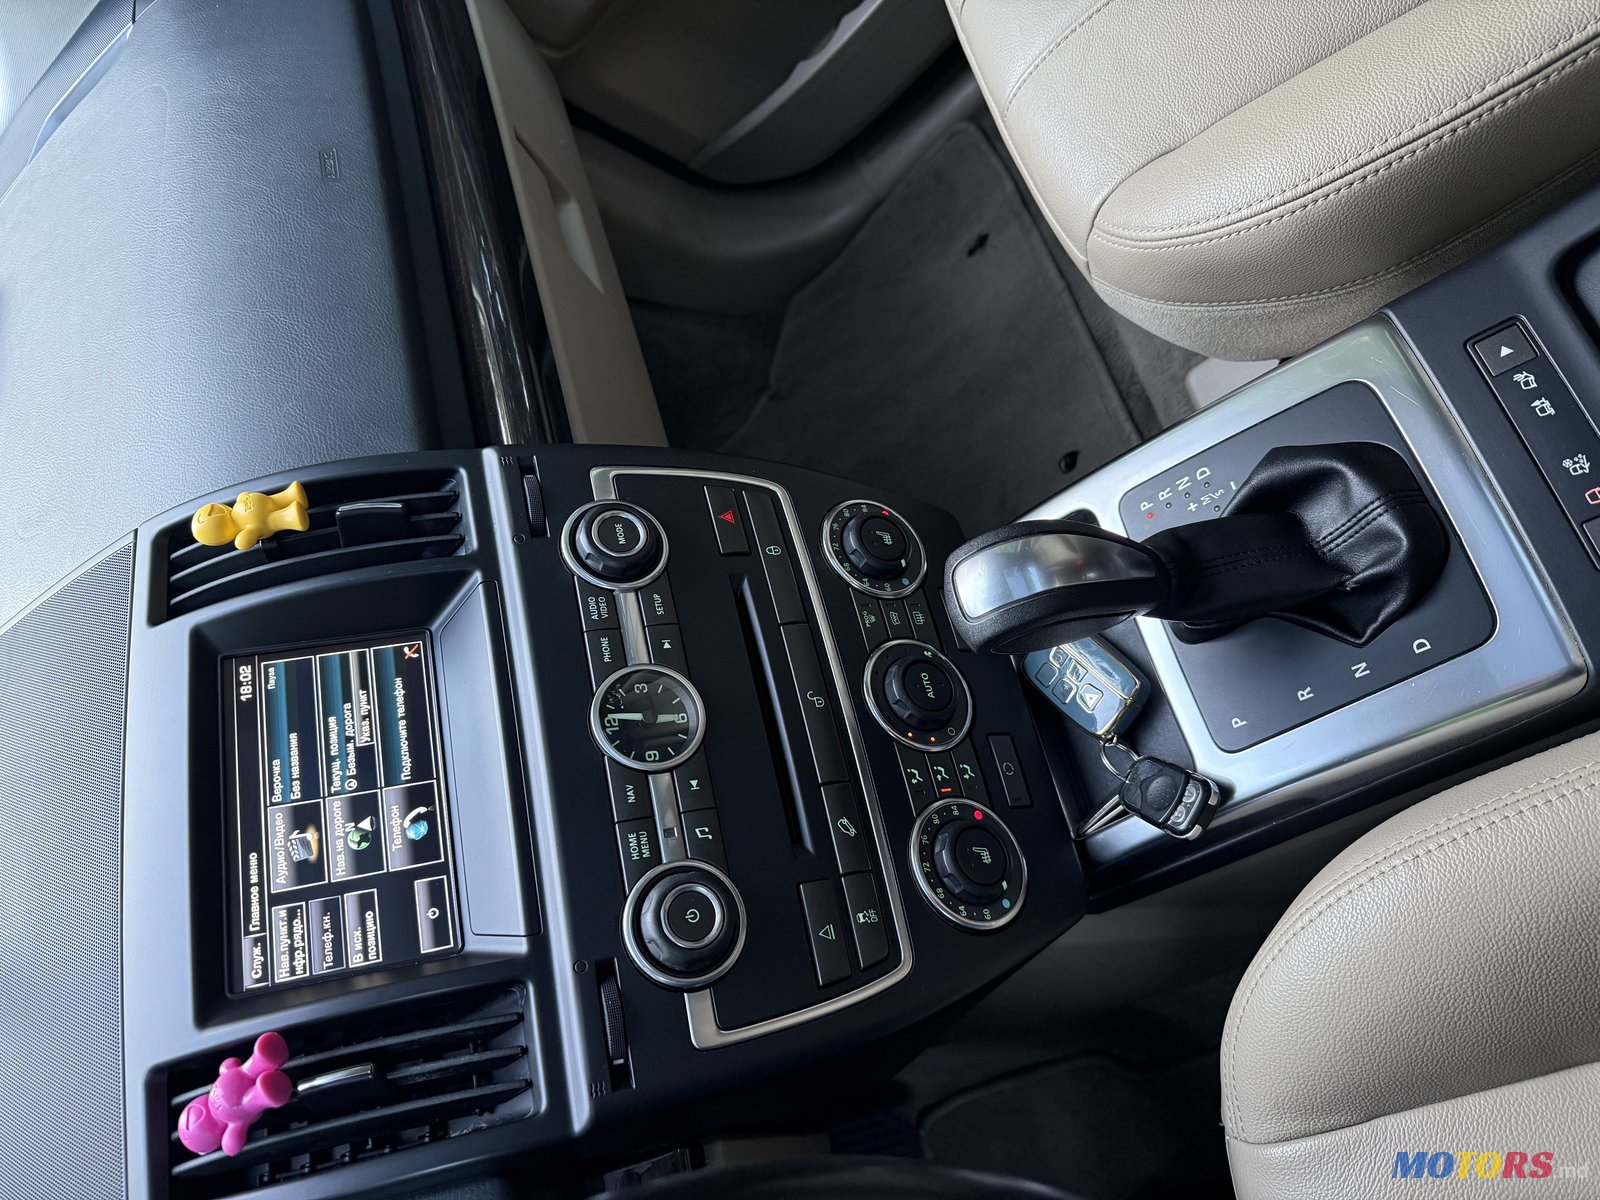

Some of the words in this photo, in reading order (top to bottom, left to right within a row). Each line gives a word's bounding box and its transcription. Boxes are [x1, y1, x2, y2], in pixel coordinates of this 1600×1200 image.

[1140, 501, 1155, 512] P
[1158, 487, 1173, 501] R
[1175, 475, 1193, 491] N
[1195, 466, 1212, 481] D
[614, 523, 626, 544] MODE
[587, 596, 599, 620] AUDIO
[598, 596, 609, 619] VIDEO
[653, 593, 665, 615] SETUP
[600, 636, 612, 662] PHONE
[1412, 638, 1432, 654] D
[239, 665, 252, 701] 18:02
[267, 667, 276, 689] Пауза
[1351, 661, 1371, 679] N
[394, 677, 407, 717] телефон
[634, 683, 648, 693] 3
[921, 672, 936, 699] AUTO
[1297, 686, 1315, 701] R
[359, 689, 372, 715] пункт
[344, 703, 356, 737] дорога
[360, 717, 372, 743] Указ.
[1231, 717, 1248, 729] P
[328, 716, 339, 756] позиция
[399, 718, 412, 780] Подключите
[289, 732, 300, 777] названия
[346, 737, 357, 776] Безым.
[645, 750, 659, 761] 9
[272, 759, 281, 803] Верочка
[290, 778, 301, 800] Без
[331, 758, 342, 794] Текущ.
[625, 784, 636, 803] NAV
[333, 799, 345, 842] дороге
[931, 813, 940, 825] 80
[951, 805, 960, 816] 84
[391, 805, 402, 851] Телефон
[920, 834, 928, 845] 76
[275, 812, 288, 884] Аудио/Видео
[627, 831, 640, 860] HOME
[639, 831, 651, 858] MENU
[248, 852, 259, 885] меню
[922, 861, 932, 873] 72
[936, 887, 945, 899] 68
[249, 887, 260, 931] Главное
[869, 908, 879, 923] OFF
[958, 905, 967, 917] 64
[982, 908, 992, 920] 60
[278, 909, 292, 978] Нав.пункт.и
[322, 912, 335, 970] Телеф.кн.
[351, 926, 363, 950] исх.
[365, 911, 379, 960] позицию
[251, 942, 262, 979] Служ.
[353, 953, 363, 963] В
